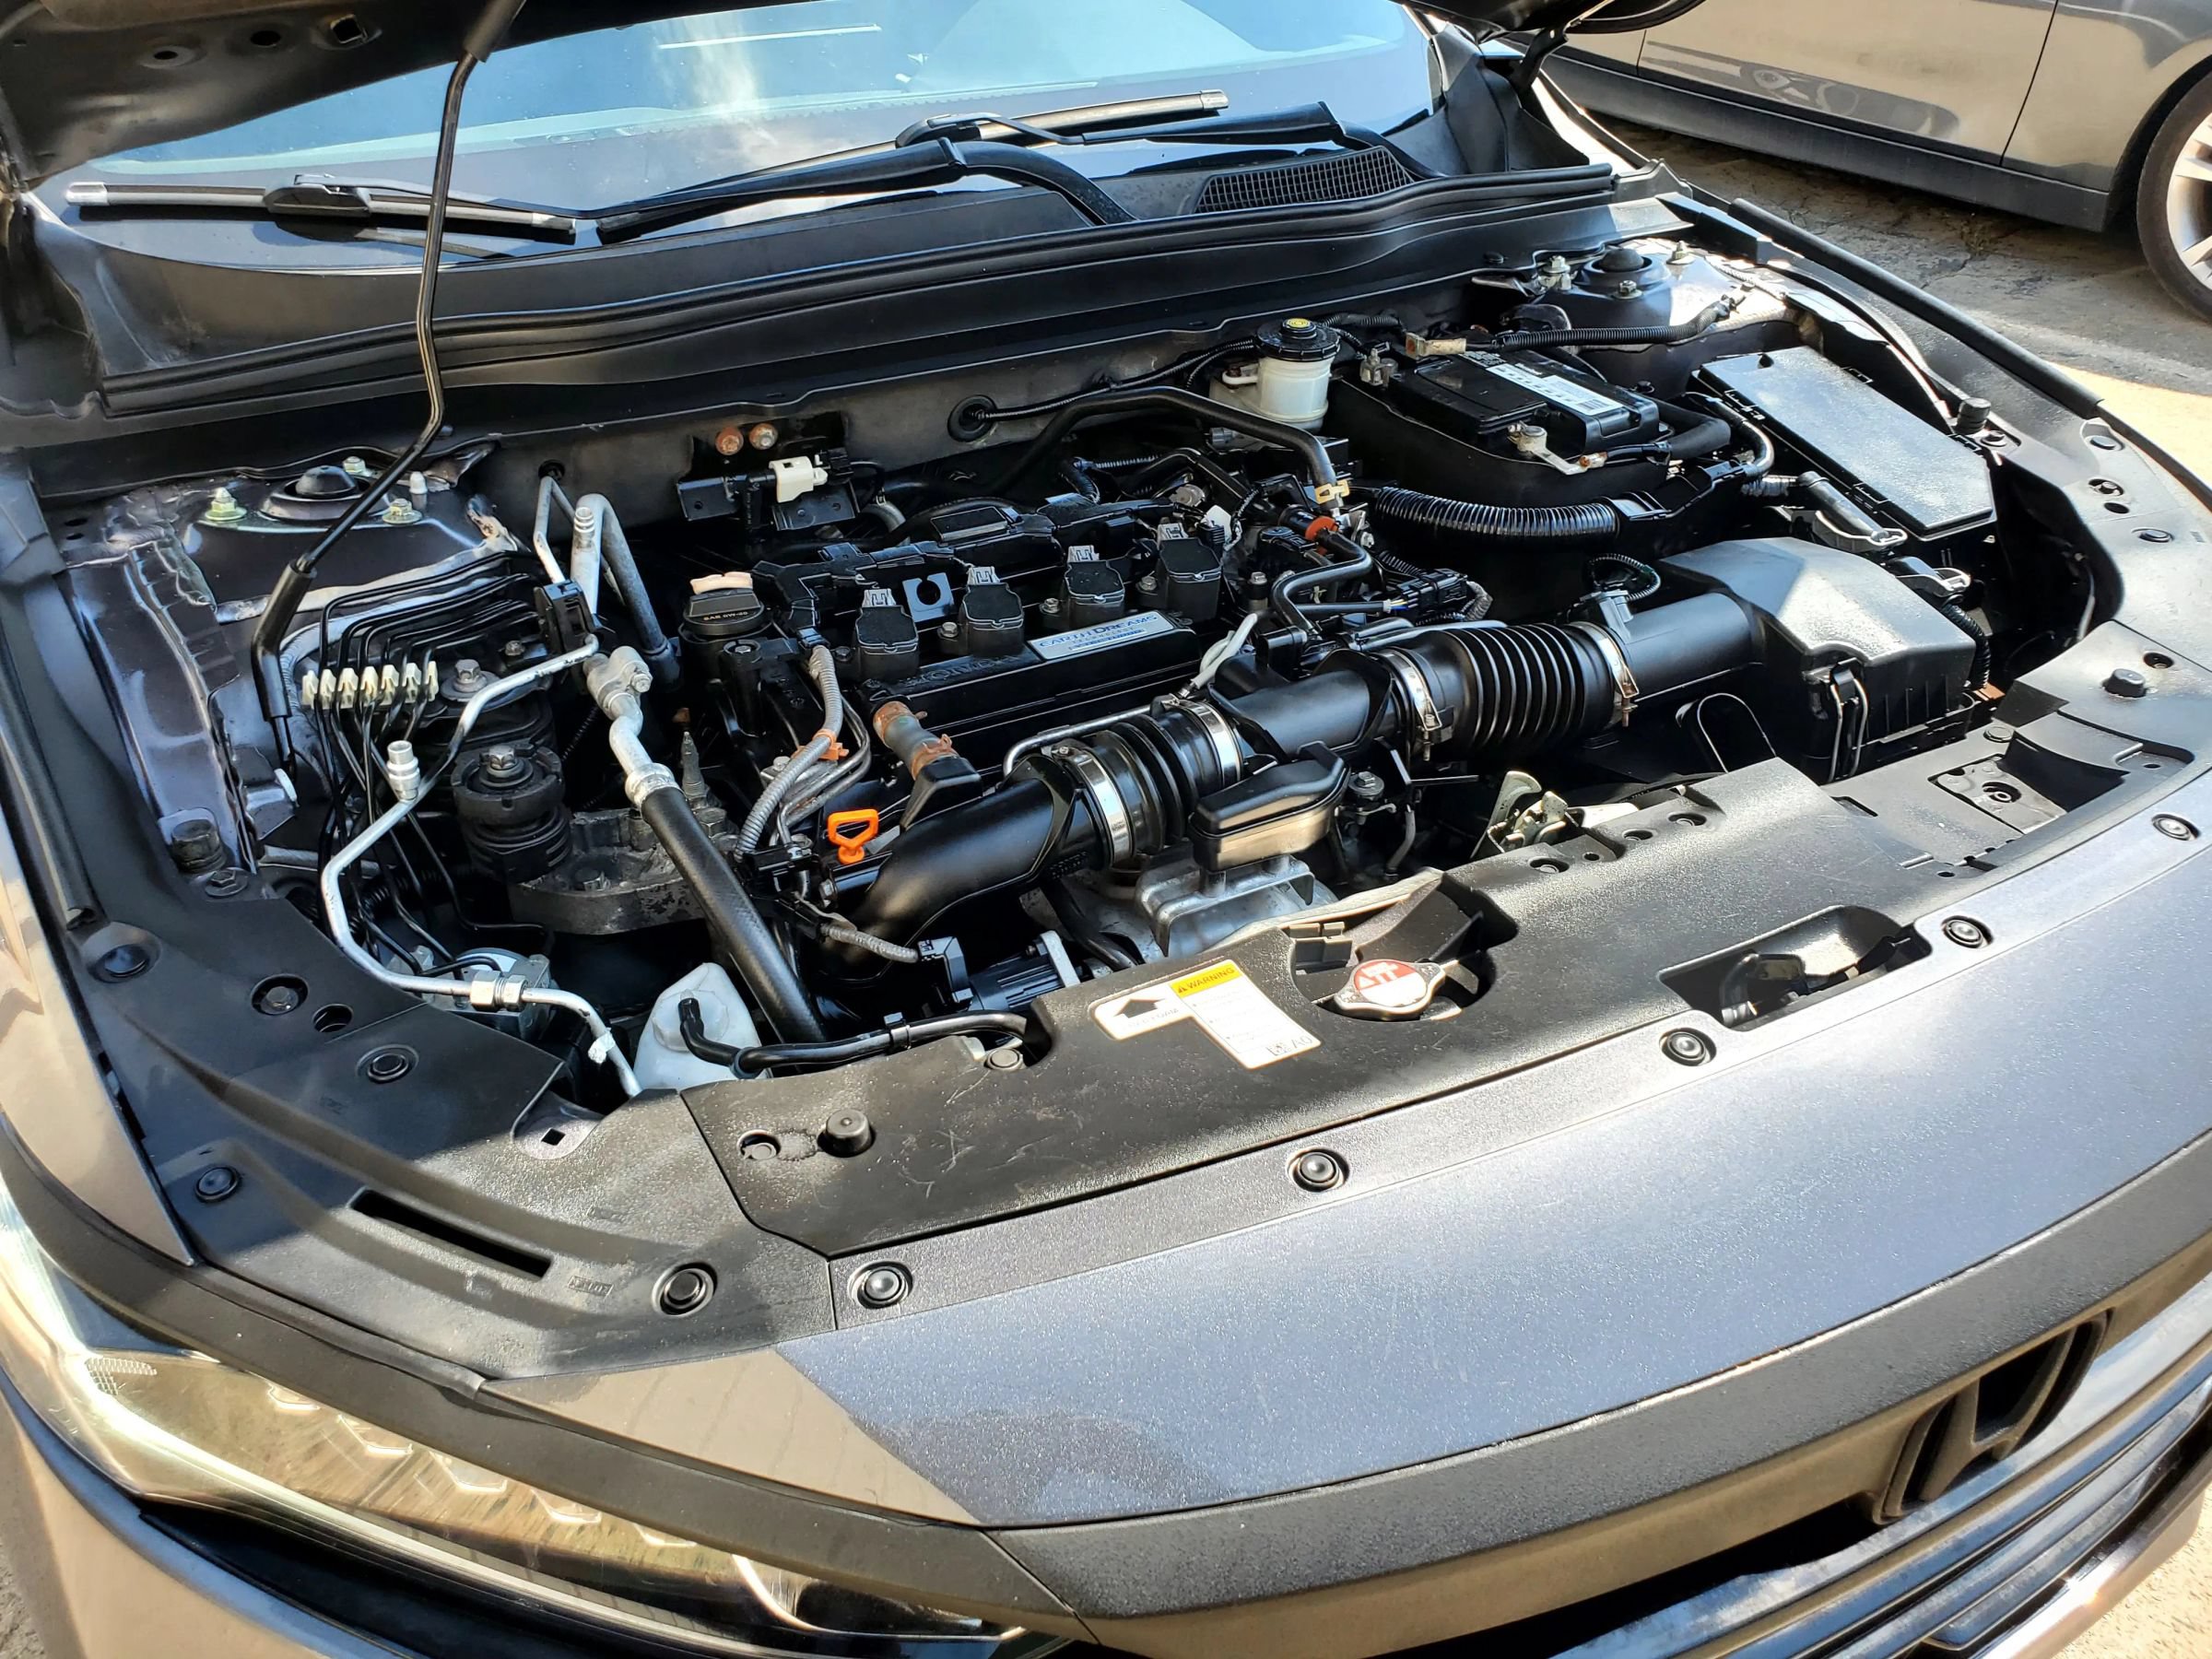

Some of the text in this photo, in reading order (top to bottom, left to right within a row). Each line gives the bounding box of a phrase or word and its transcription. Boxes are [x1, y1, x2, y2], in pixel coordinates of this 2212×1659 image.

[1040, 615, 1158, 648] EARTH DREAMS
[1186, 967, 1235, 989] WARNING
